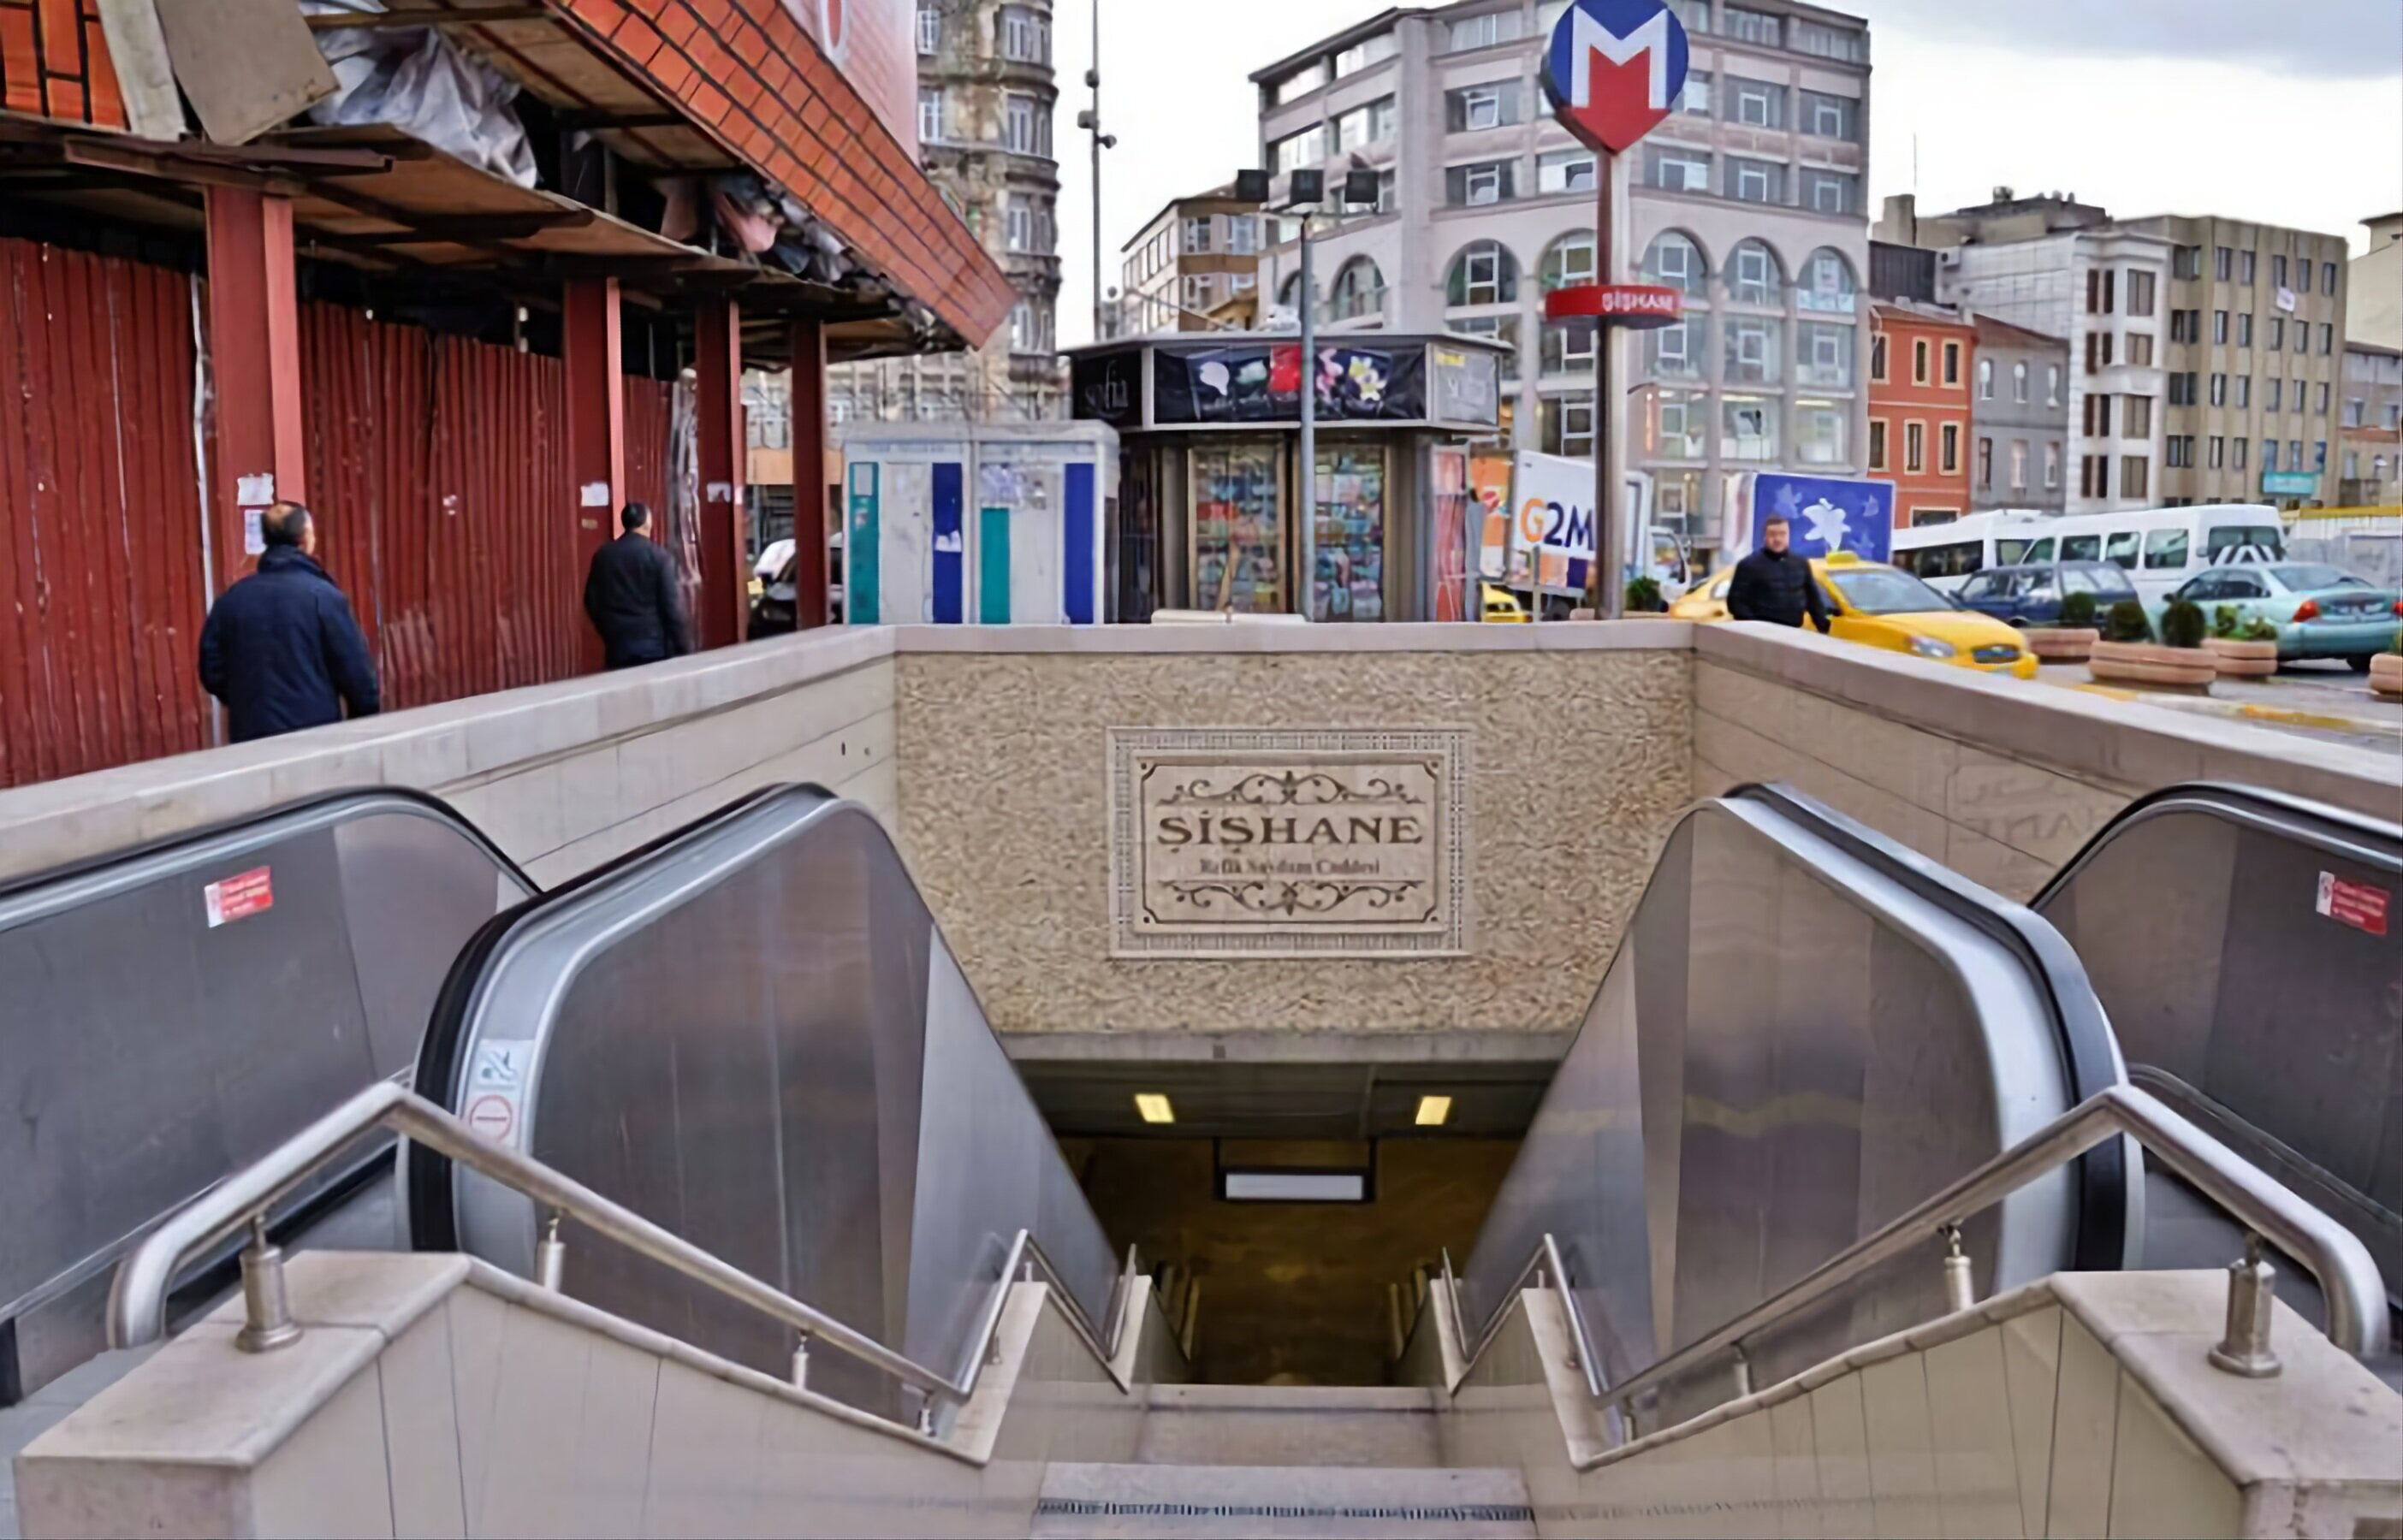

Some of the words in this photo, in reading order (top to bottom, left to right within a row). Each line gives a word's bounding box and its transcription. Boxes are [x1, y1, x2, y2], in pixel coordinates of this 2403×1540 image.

[1571, 4, 1668, 109] M
[1520, 497, 1594, 551] G2M
[1157, 809, 1422, 854] ŞİŞHANE
